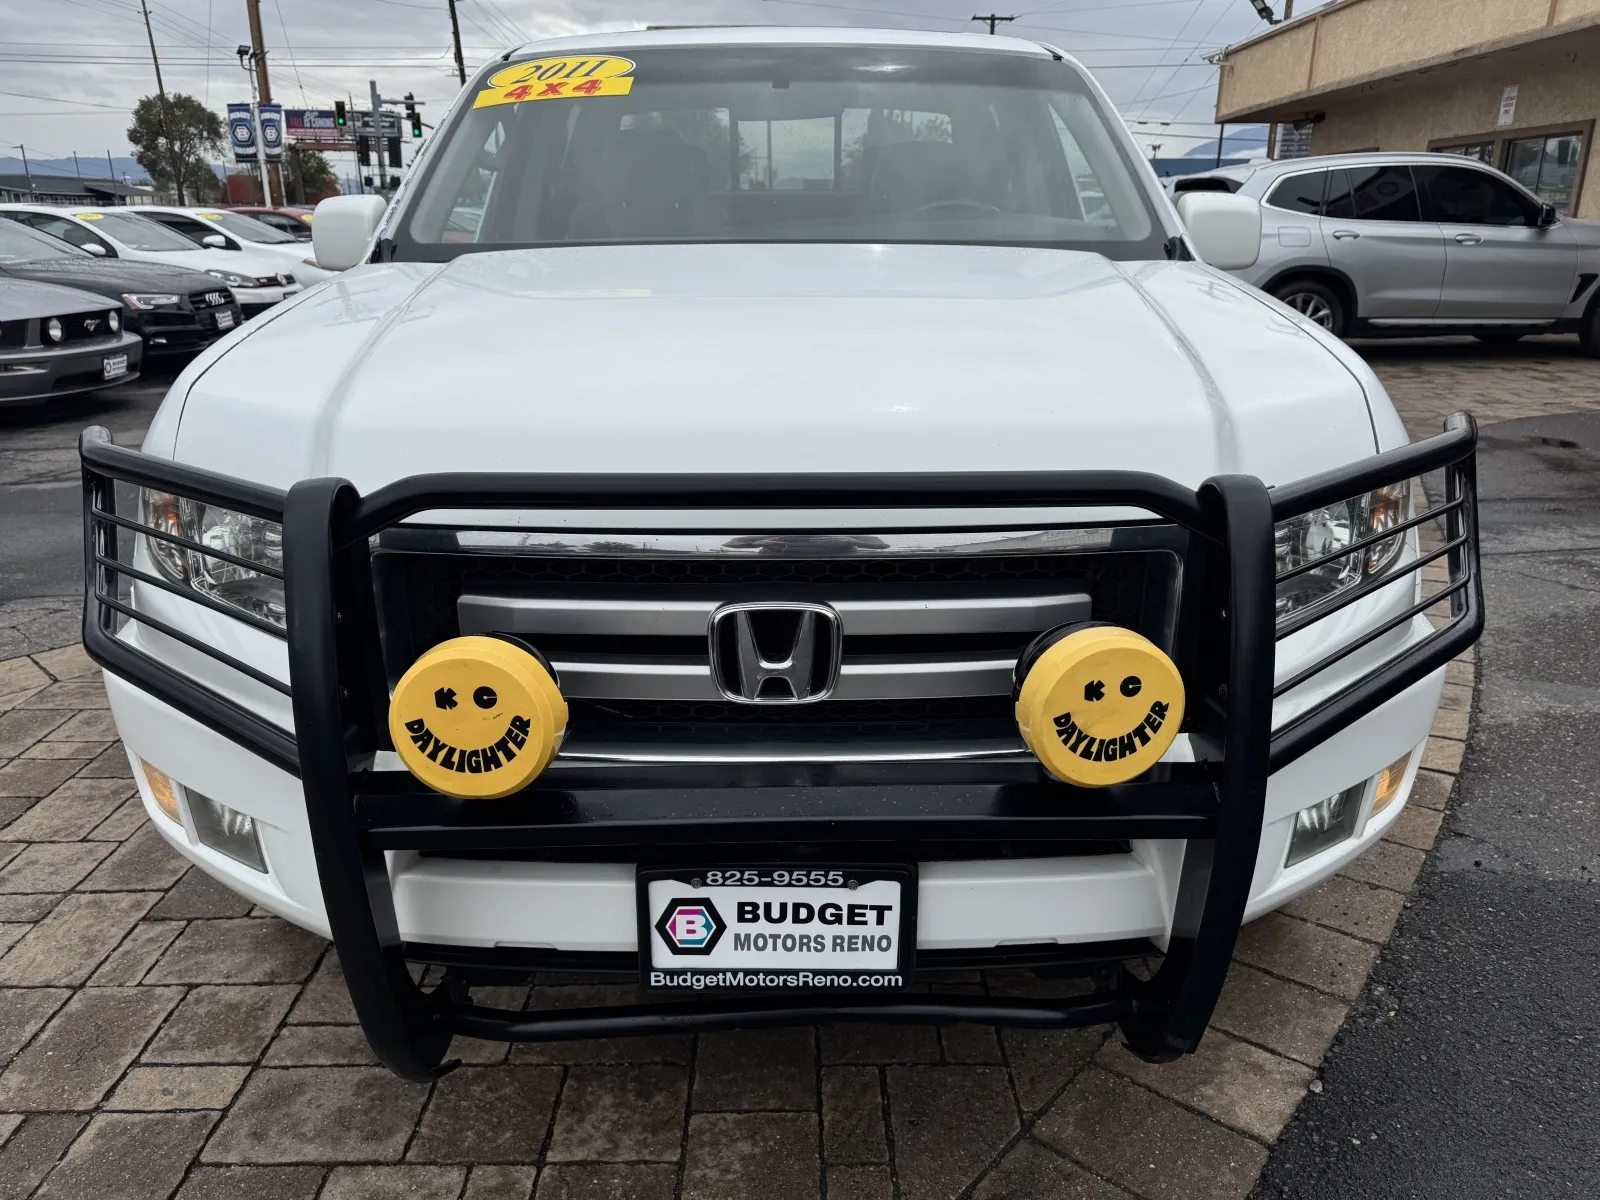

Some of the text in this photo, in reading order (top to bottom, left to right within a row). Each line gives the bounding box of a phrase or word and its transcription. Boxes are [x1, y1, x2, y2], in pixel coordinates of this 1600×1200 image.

[510, 59, 609, 84] 2011
[404, 714, 531, 774] DAYLIGHTER
[1052, 700, 1170, 763] DAYLIGHTER
[705, 870, 844, 886] 825-9555
[736, 901, 893, 926] BUDGET
[733, 933, 892, 953] MOTORS RENO
[650, 971, 903, 989] BudgetMotorsReno.com
